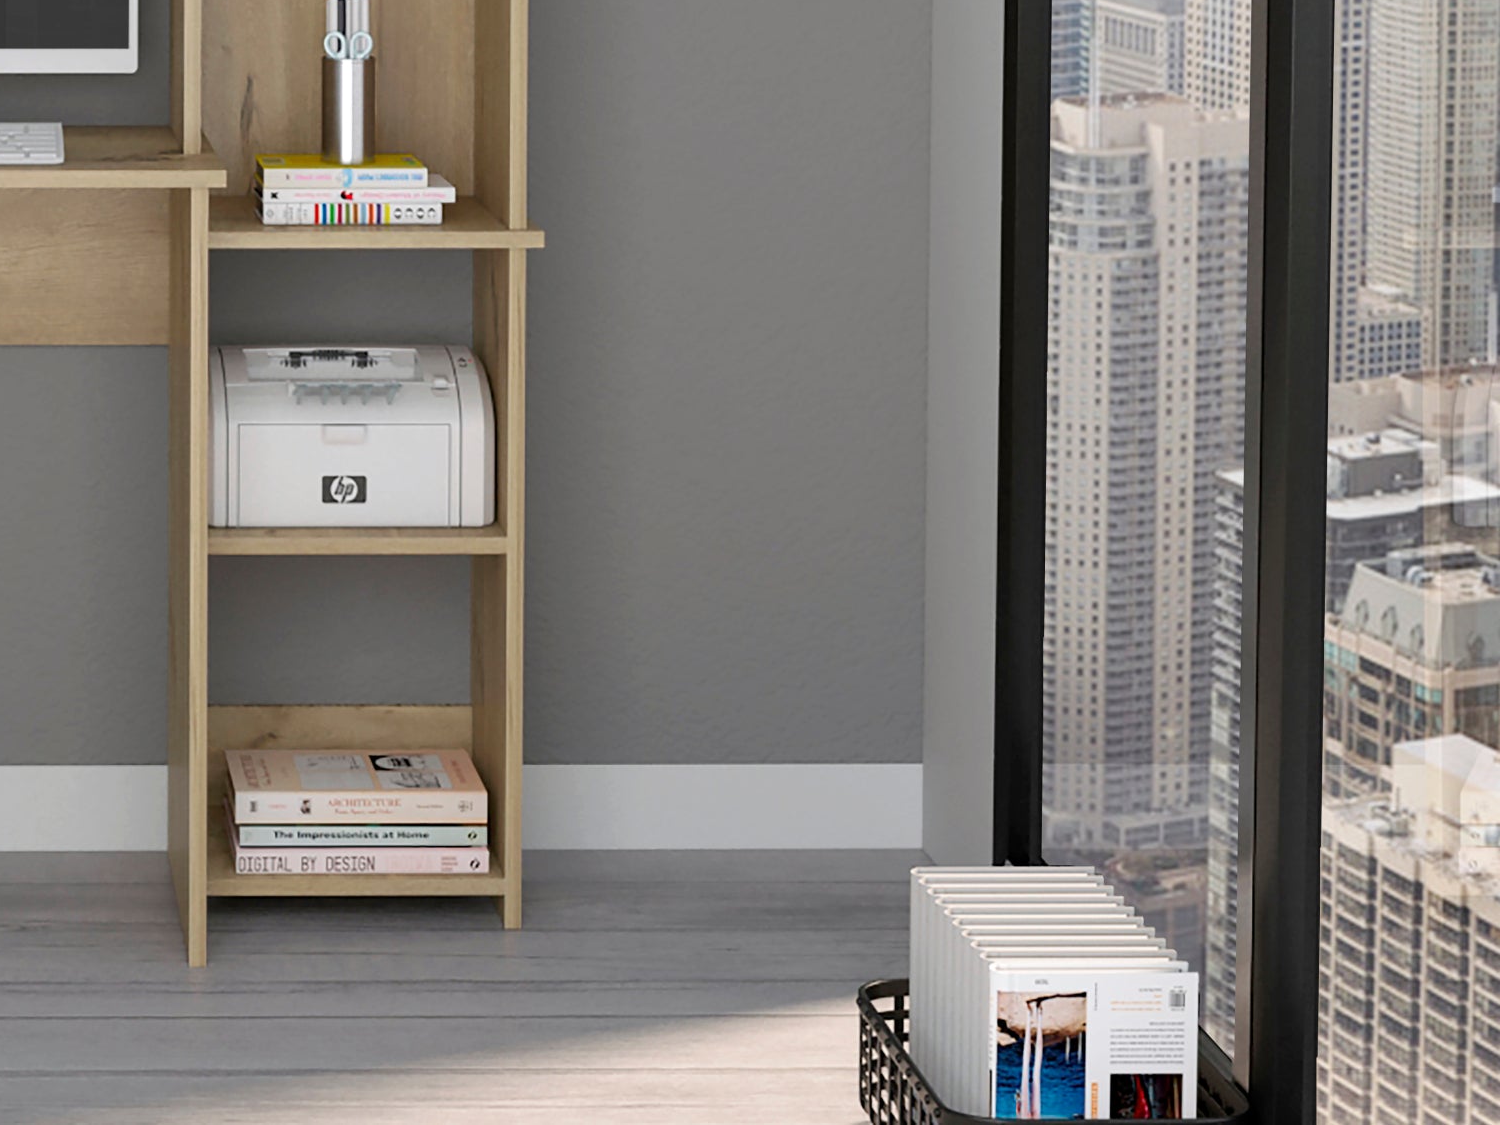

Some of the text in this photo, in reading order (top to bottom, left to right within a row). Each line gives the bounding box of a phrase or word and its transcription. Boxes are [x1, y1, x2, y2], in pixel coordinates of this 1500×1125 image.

[335, 476, 354, 504] hp
[328, 798, 402, 807] ARCHITECTURE
[274, 830, 430, 841] The Impressionists at Home
[237, 856, 292, 873] DIGITAL
[301, 856, 317, 872] BY
[326, 856, 376, 872] DESIGN
